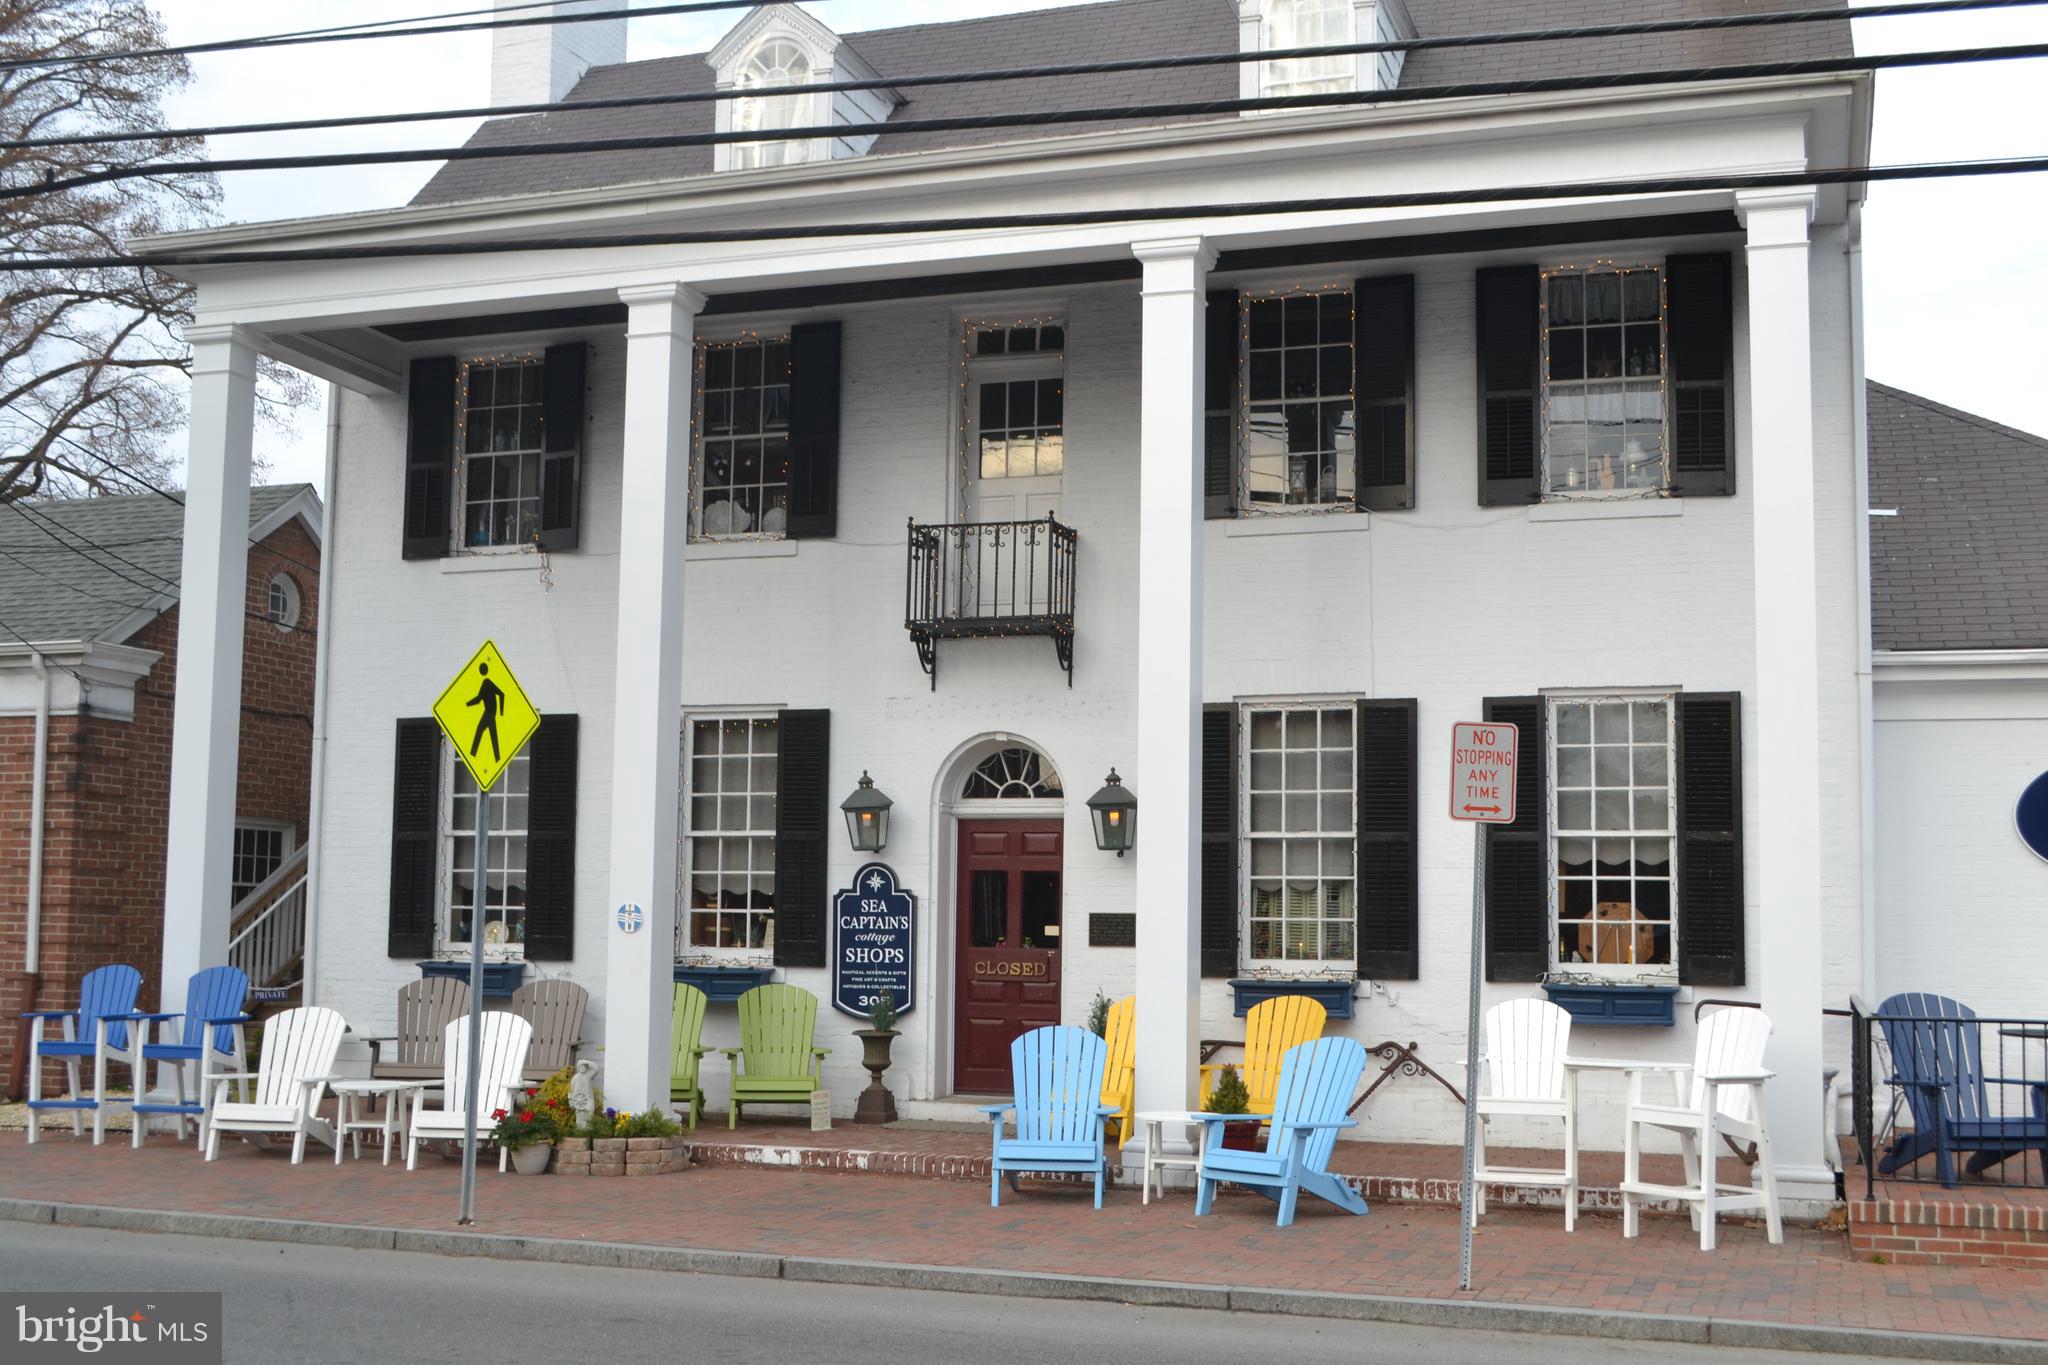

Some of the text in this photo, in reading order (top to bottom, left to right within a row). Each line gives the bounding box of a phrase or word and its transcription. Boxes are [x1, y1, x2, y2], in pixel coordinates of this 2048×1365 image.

[1473, 730, 1495, 746] NO
[1456, 749, 1512, 766] STOPPING
[1469, 769, 1498, 782] ANY
[1466, 785, 1499, 799] TIME
[861, 899, 888, 913] SEA
[841, 916, 909, 929] CAPTAIN'S
[855, 932, 896, 945] cottage
[846, 948, 904, 963] SHOPS
[975, 961, 1046, 976] CLOSED
[255, 991, 286, 999] PRIVATE
